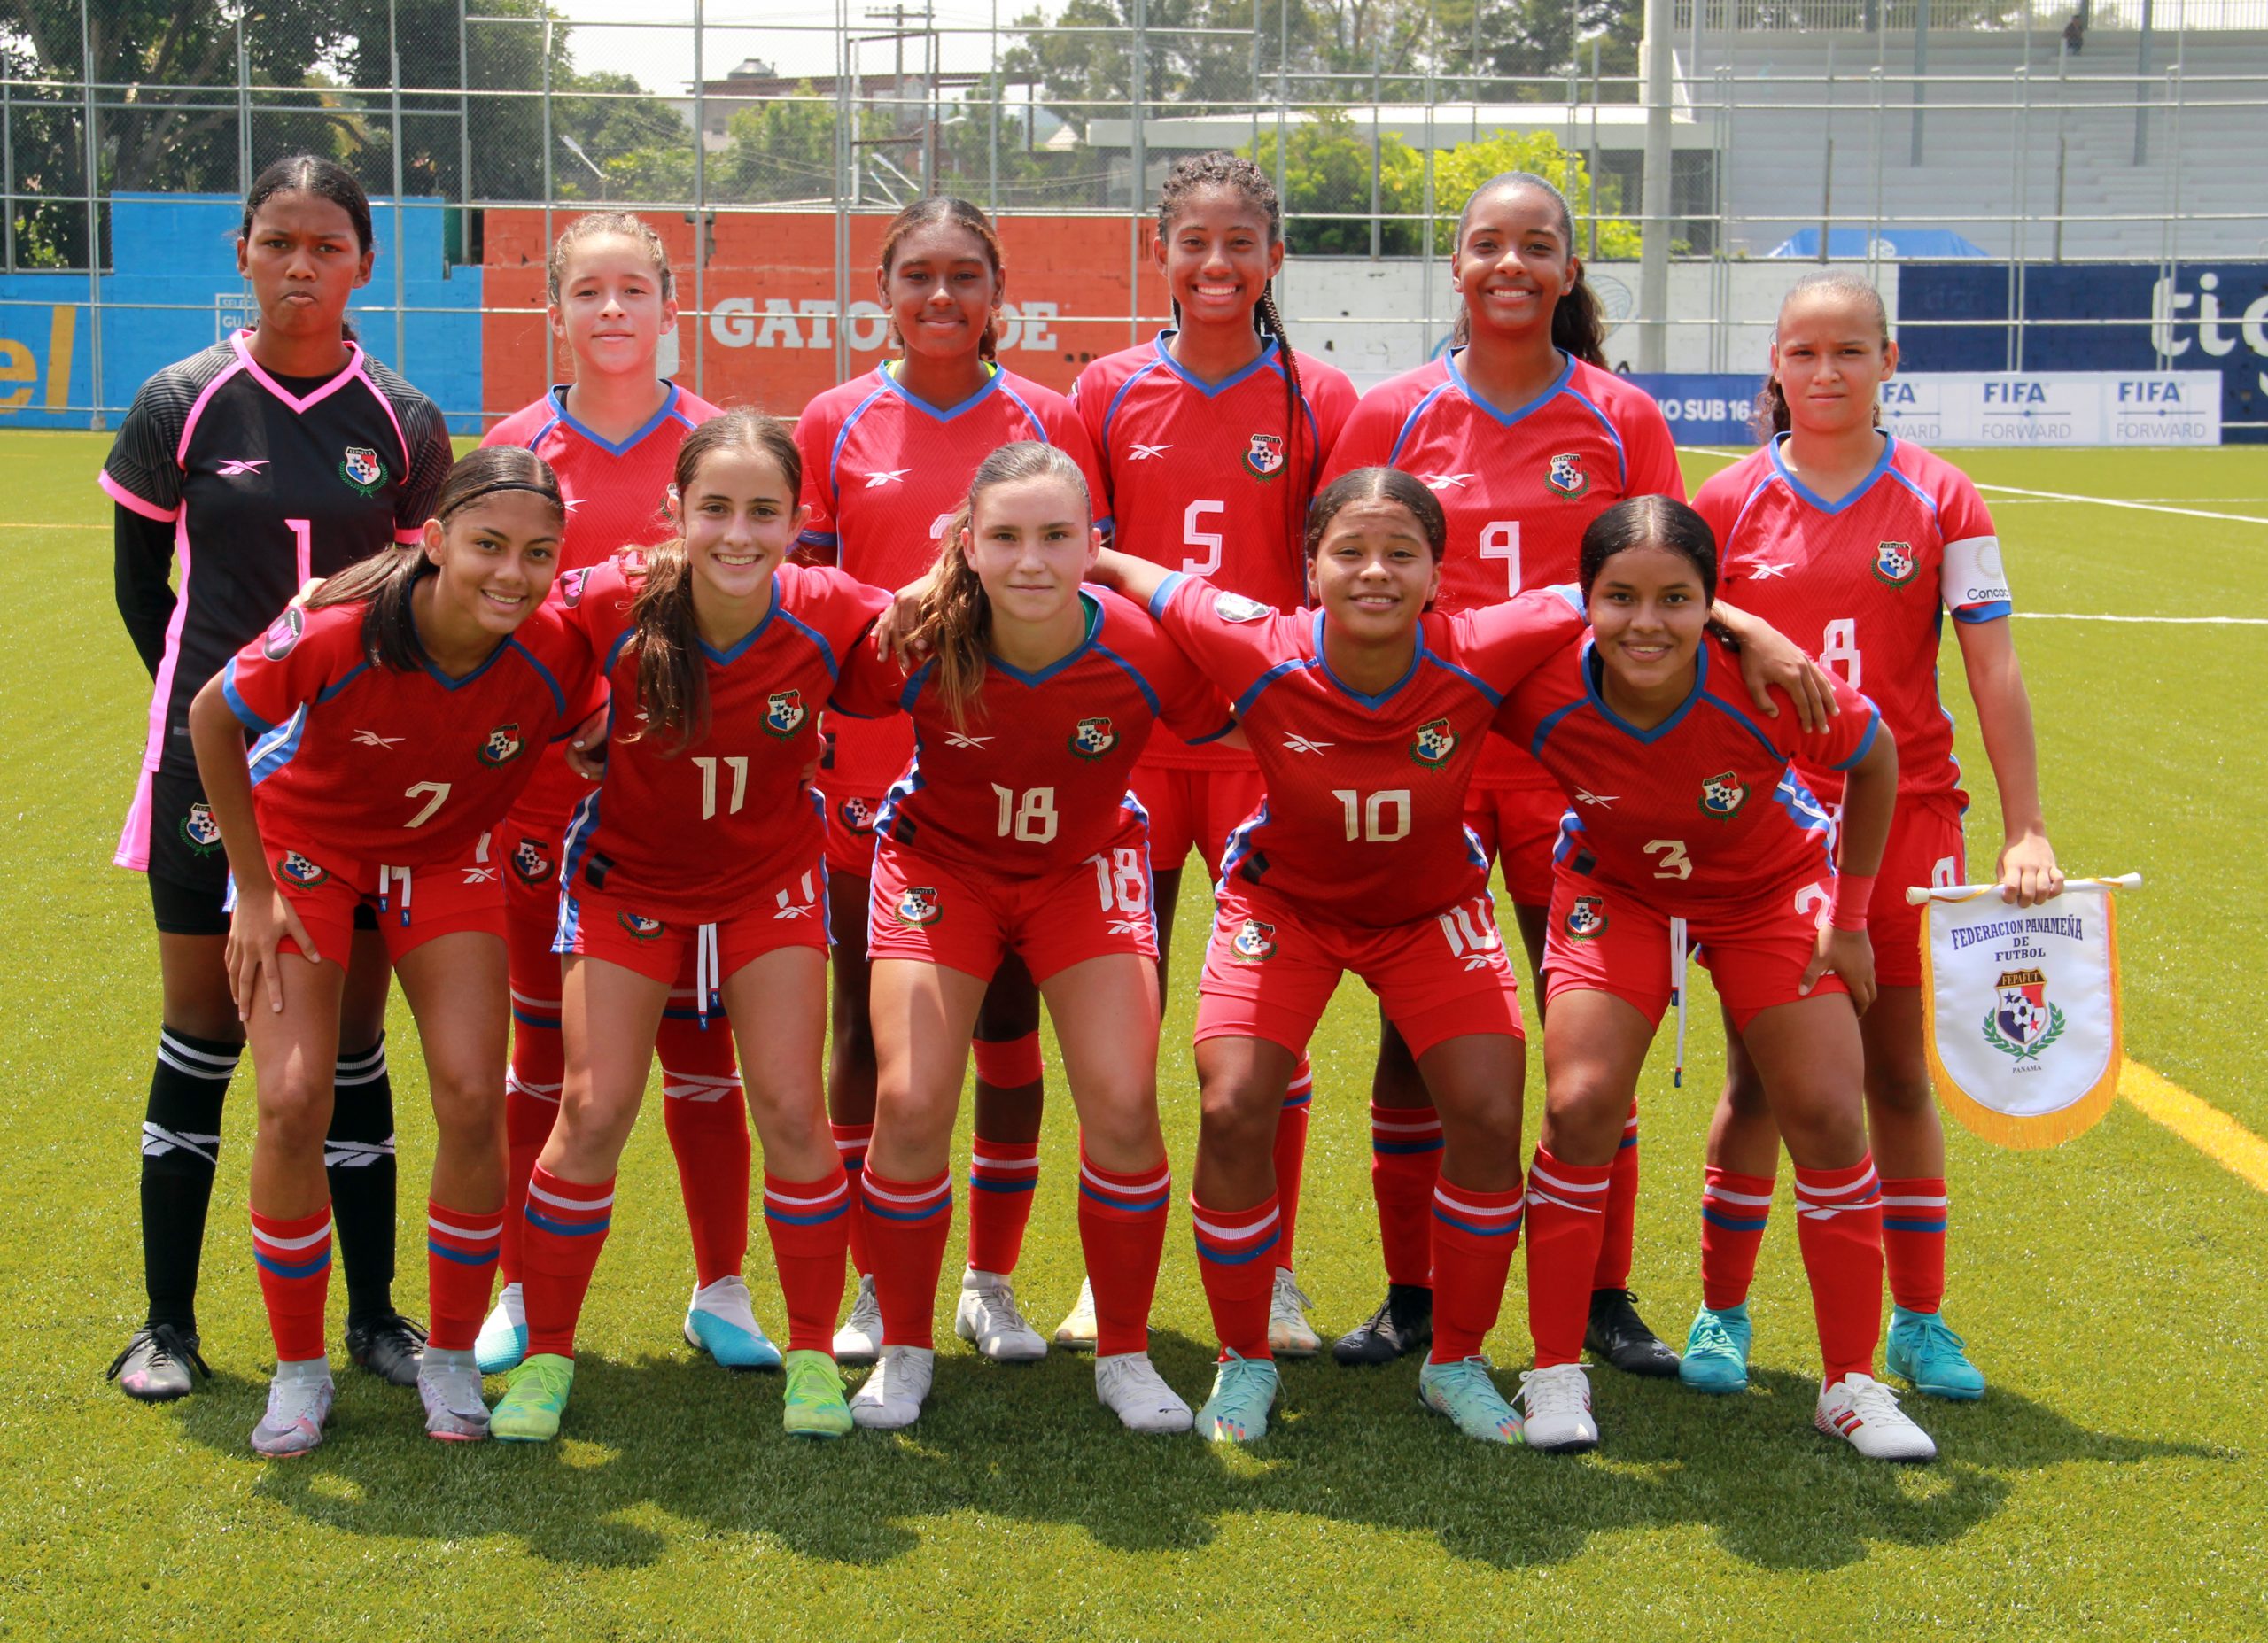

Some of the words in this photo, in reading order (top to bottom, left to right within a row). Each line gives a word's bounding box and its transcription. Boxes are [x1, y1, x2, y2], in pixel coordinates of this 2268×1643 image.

[710, 298, 1058, 351] GATODE
[1684, 399, 1727, 422] SUB
[1728, 399, 1751, 422] 16
[1984, 383, 2046, 402] FIFA
[2118, 382, 2180, 401] FIFA
[1982, 423, 2071, 439] FORWARD
[2117, 422, 2206, 438] FORWARD
[284, 519, 311, 594] 1
[1183, 500, 1224, 576] 5
[1480, 521, 1521, 598] 9
[1820, 618, 1861, 692] 8
[403, 781, 452, 828] 7
[691, 756, 749, 820] 11
[991, 782, 1058, 844] 18
[1332, 789, 1410, 842] 10
[1082, 848, 1146, 912] 18
[1643, 840, 1693, 880] 3
[1951, 920, 2023, 950] FEDERACION
[2025, 913, 2084, 941] PANAMEÑA
[2013, 936, 2029, 947] DE
[1995, 948, 2046, 962] FUTBOL
[2001, 973, 2039, 986] FEPAFUT
